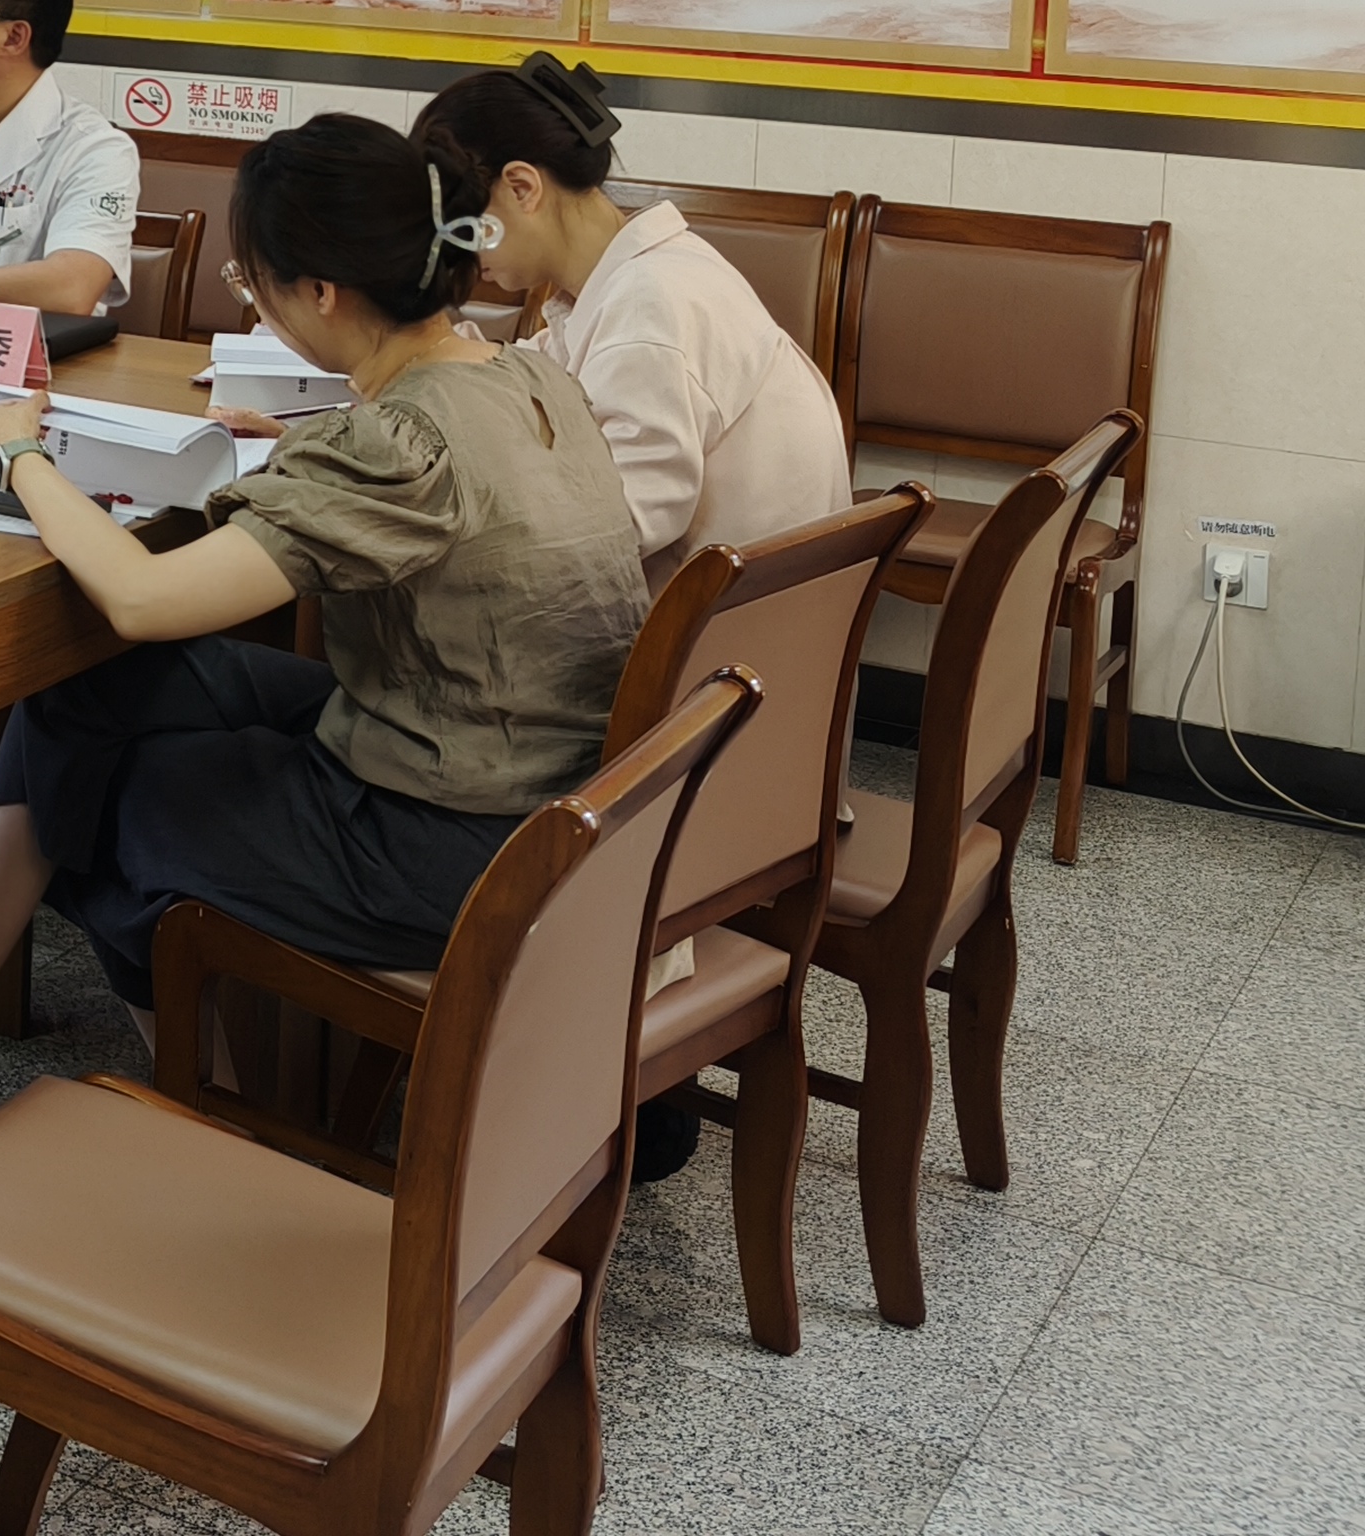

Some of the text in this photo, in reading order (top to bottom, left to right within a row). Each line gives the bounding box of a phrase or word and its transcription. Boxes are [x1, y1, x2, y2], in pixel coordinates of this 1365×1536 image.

[187, 81, 278, 113] 禁止吸烟
[189, 107, 275, 125] NO SMOKING
